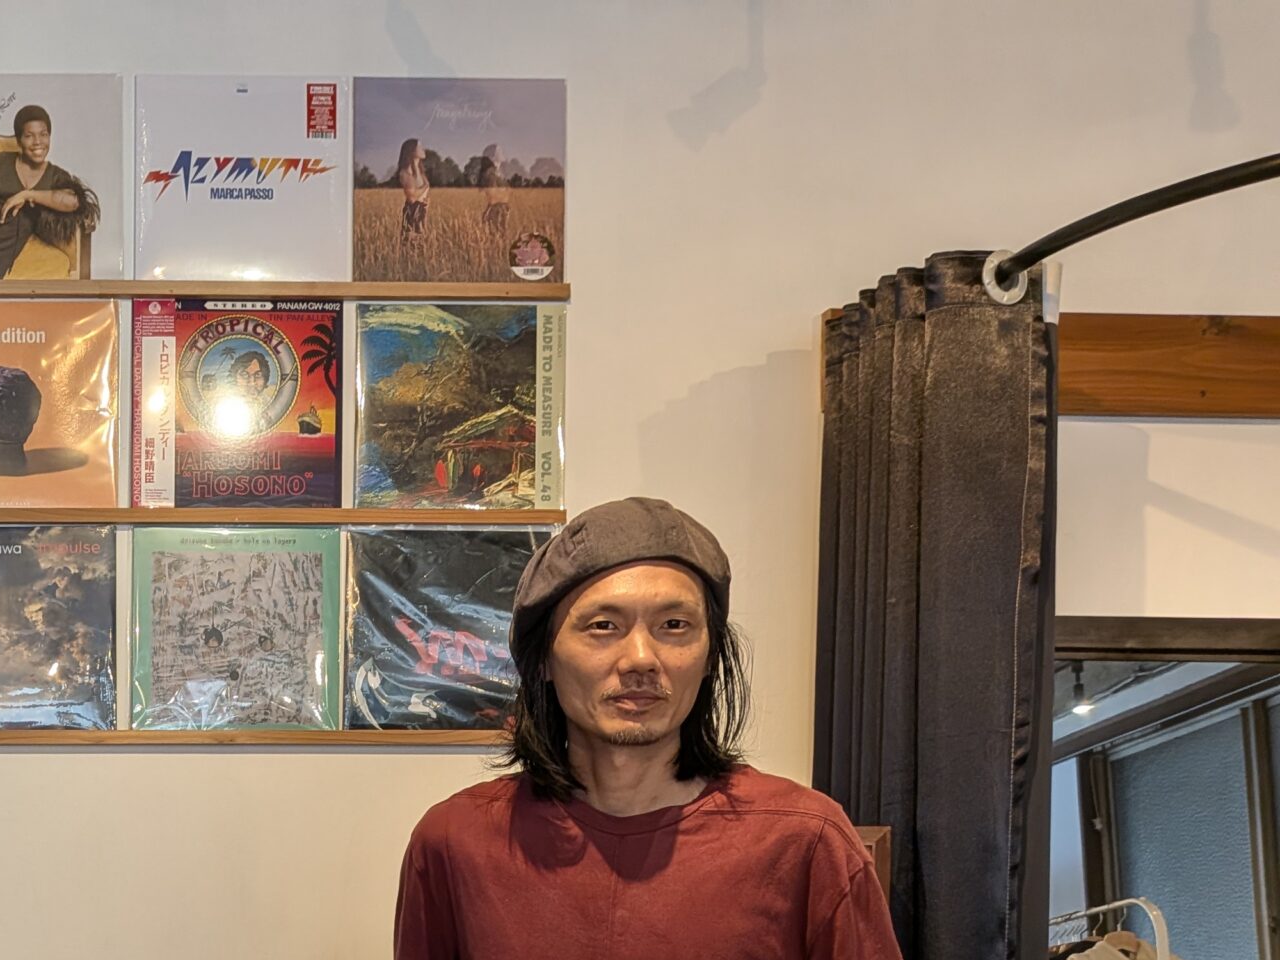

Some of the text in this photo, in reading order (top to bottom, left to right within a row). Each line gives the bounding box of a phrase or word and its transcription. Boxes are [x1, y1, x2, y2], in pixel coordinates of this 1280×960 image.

[143, 150, 337, 203] AZYMUTH
[210, 187, 274, 200] MARCA PASSO
[133, 316, 142, 365] TROPICAL
[189, 318, 284, 355] TROPICAL
[542, 315, 553, 352] MADE
[542, 355, 553, 373] TO
[133, 367, 142, 401] DANDY
[542, 376, 553, 437] MEASURE
